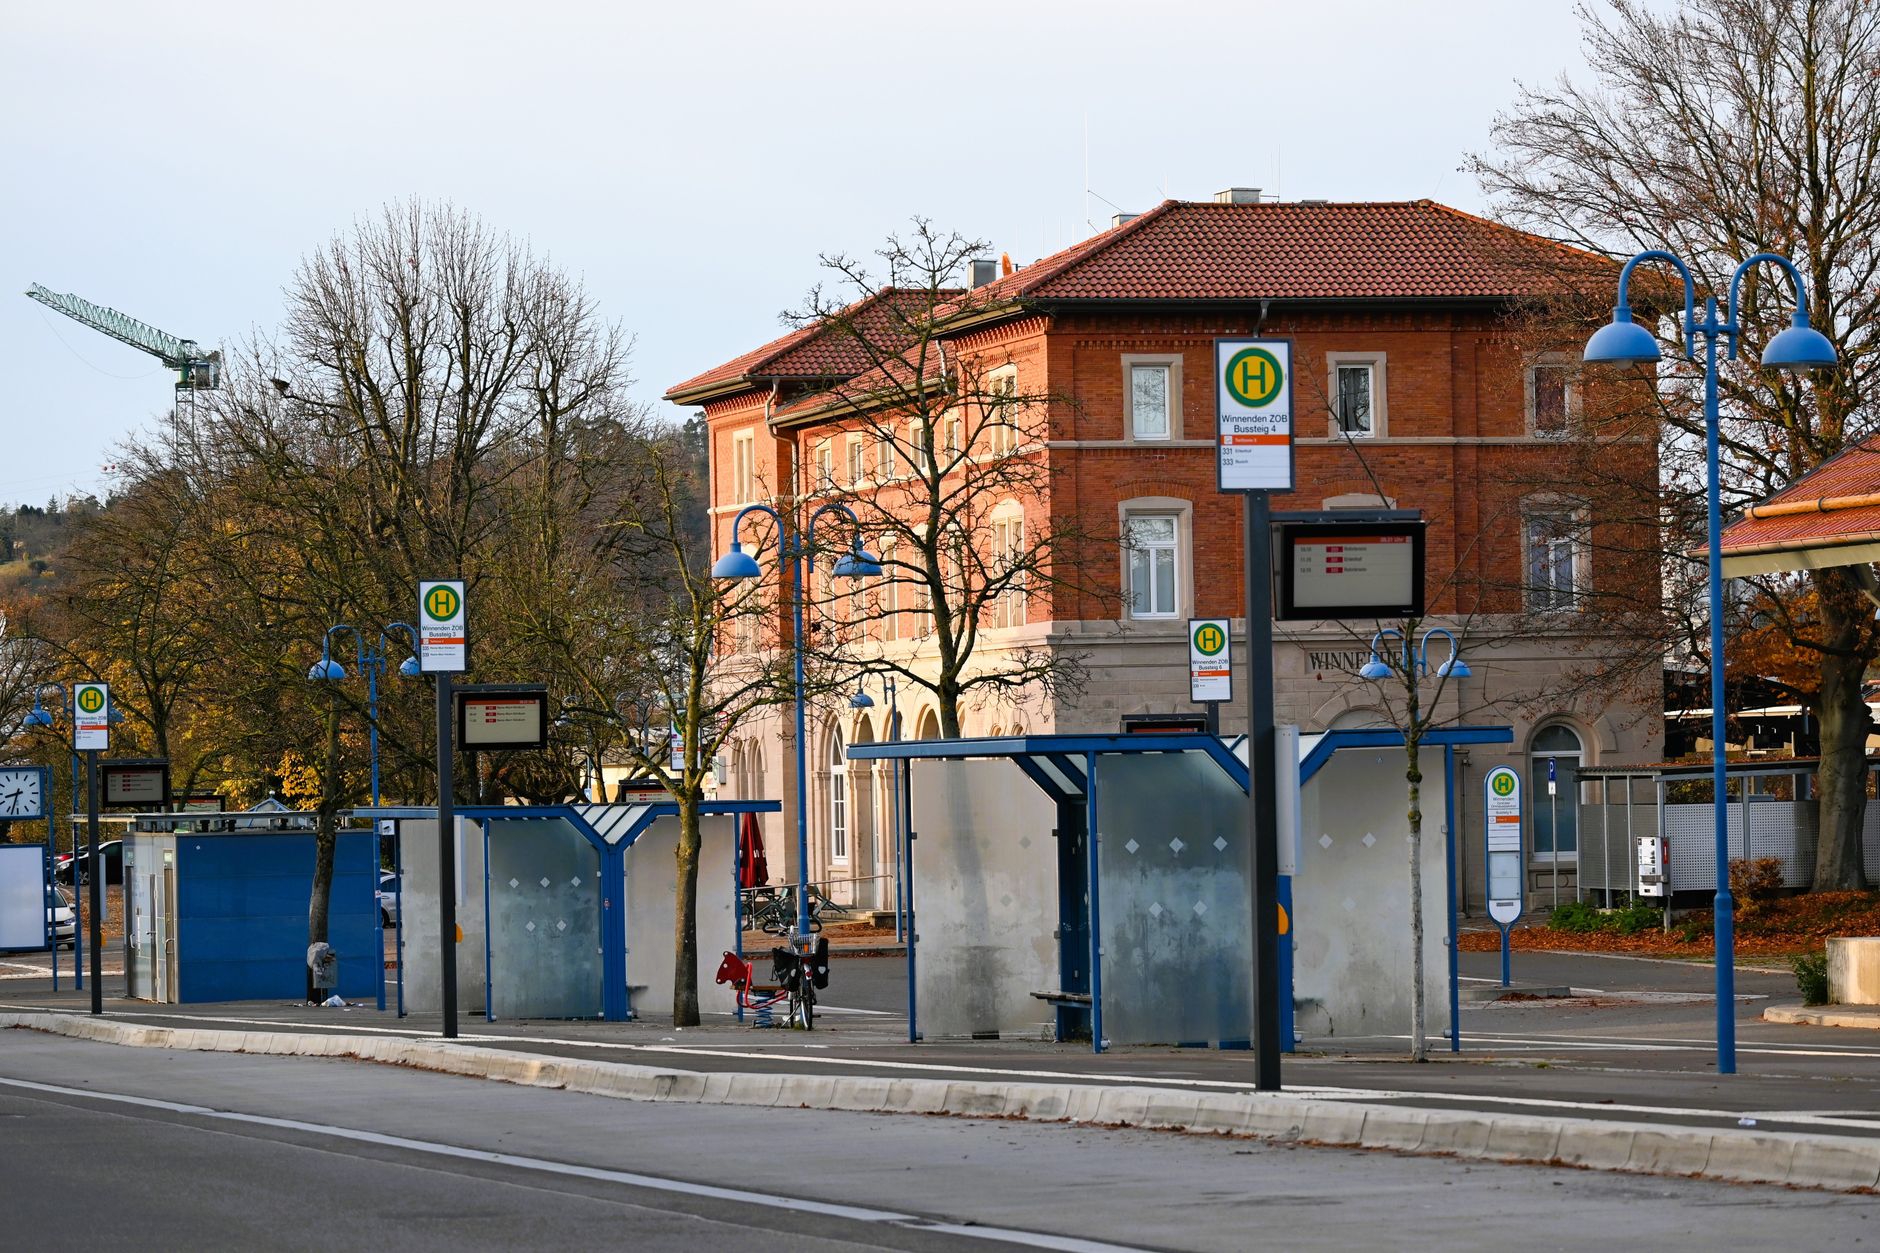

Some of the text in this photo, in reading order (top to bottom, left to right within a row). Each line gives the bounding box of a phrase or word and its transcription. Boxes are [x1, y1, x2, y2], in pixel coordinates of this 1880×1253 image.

[1242, 361, 1265, 394] H
[1222, 414, 1288, 423] Winnenden ZOB
[1234, 424, 1277, 434] Bussteig 4
[1222, 447, 1233, 455] 331
[1222, 458, 1234, 466] 333
[434, 593, 450, 614] H
[1202, 630, 1216, 649] H
[85, 692, 97, 708] H
[1497, 778, 1509, 791] H
